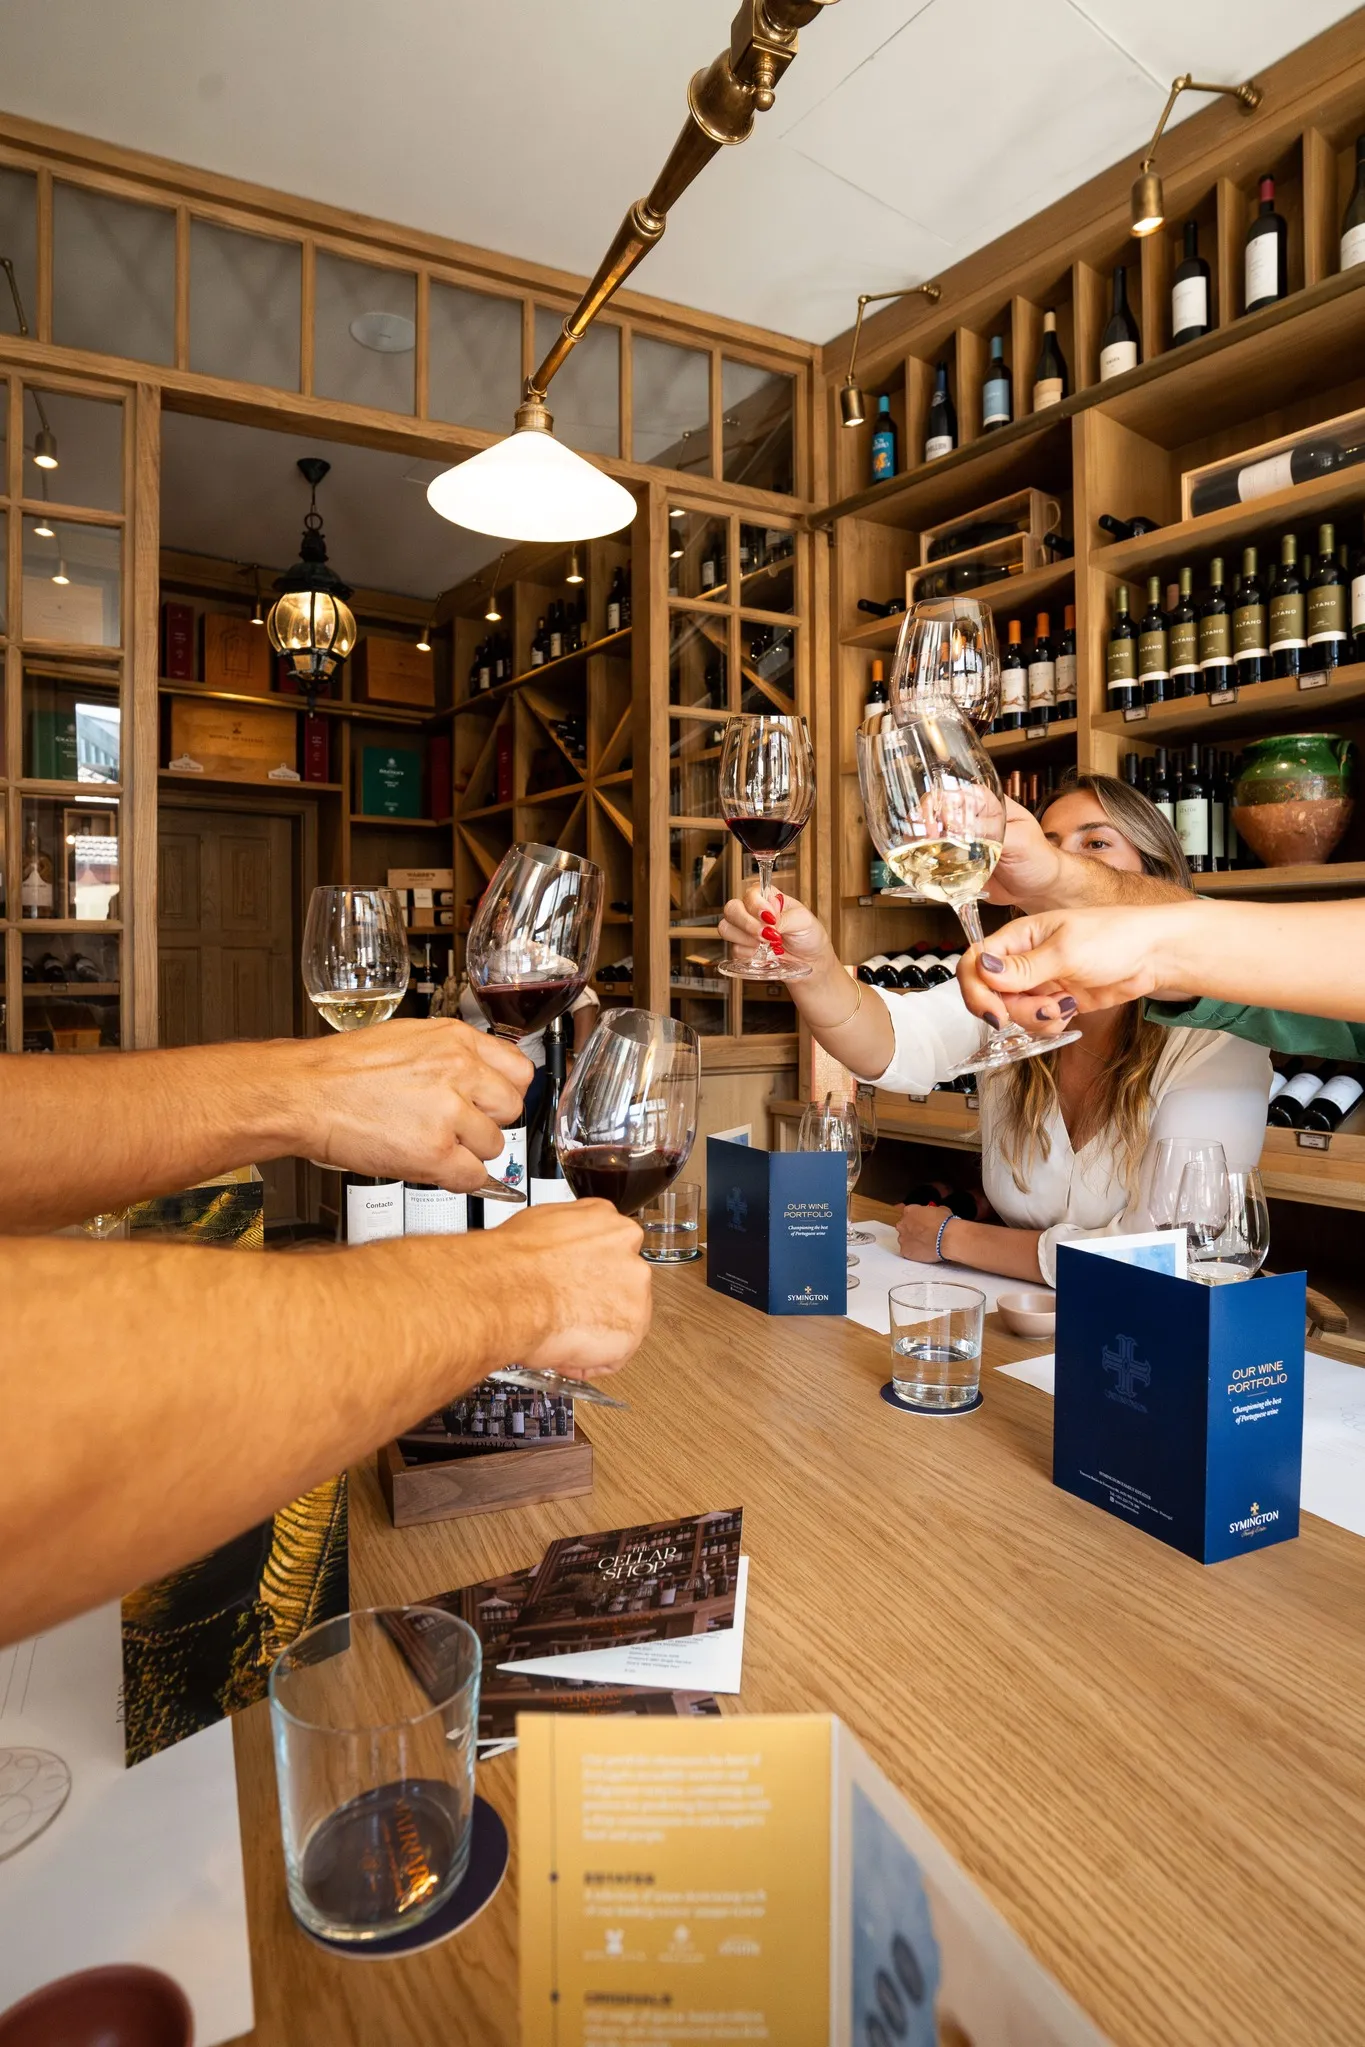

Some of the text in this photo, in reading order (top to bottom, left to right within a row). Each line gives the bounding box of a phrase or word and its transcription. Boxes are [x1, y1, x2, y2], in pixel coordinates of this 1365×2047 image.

[366, 1201, 393, 1209] Contacto
[1232, 1360, 1284, 1380] OUR WINE
[1227, 1373, 1288, 1395] PORTFOLIO
[1232, 1397, 1282, 1414] Championing the best
[1235, 1408, 1279, 1425] of Portuguese wine
[1229, 1510, 1279, 1533] SYMINGTON
[598, 1547, 677, 1569] CELLAR
[603, 1561, 666, 1580] SHOP
